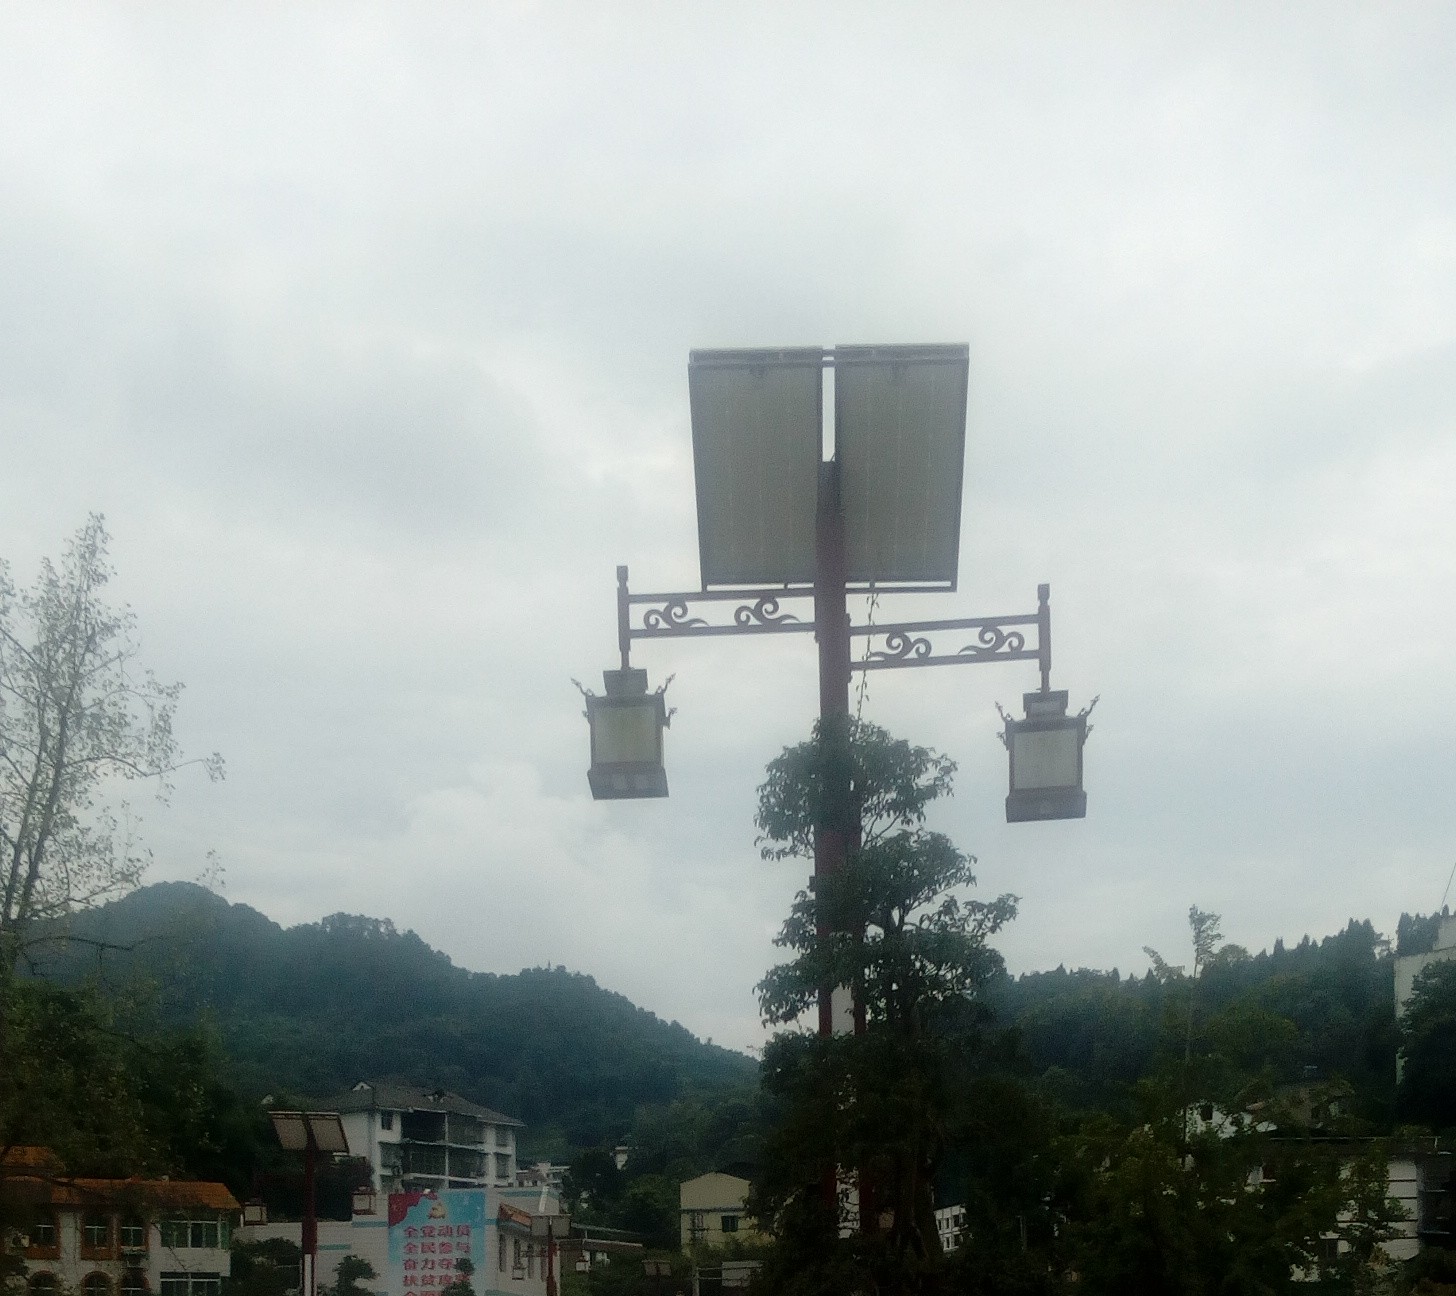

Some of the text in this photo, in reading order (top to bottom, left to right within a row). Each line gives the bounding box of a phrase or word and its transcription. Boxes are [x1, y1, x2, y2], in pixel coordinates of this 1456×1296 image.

[404, 1242, 471, 1254] 全民参与
[404, 1258, 471, 1270] 奋力夺
